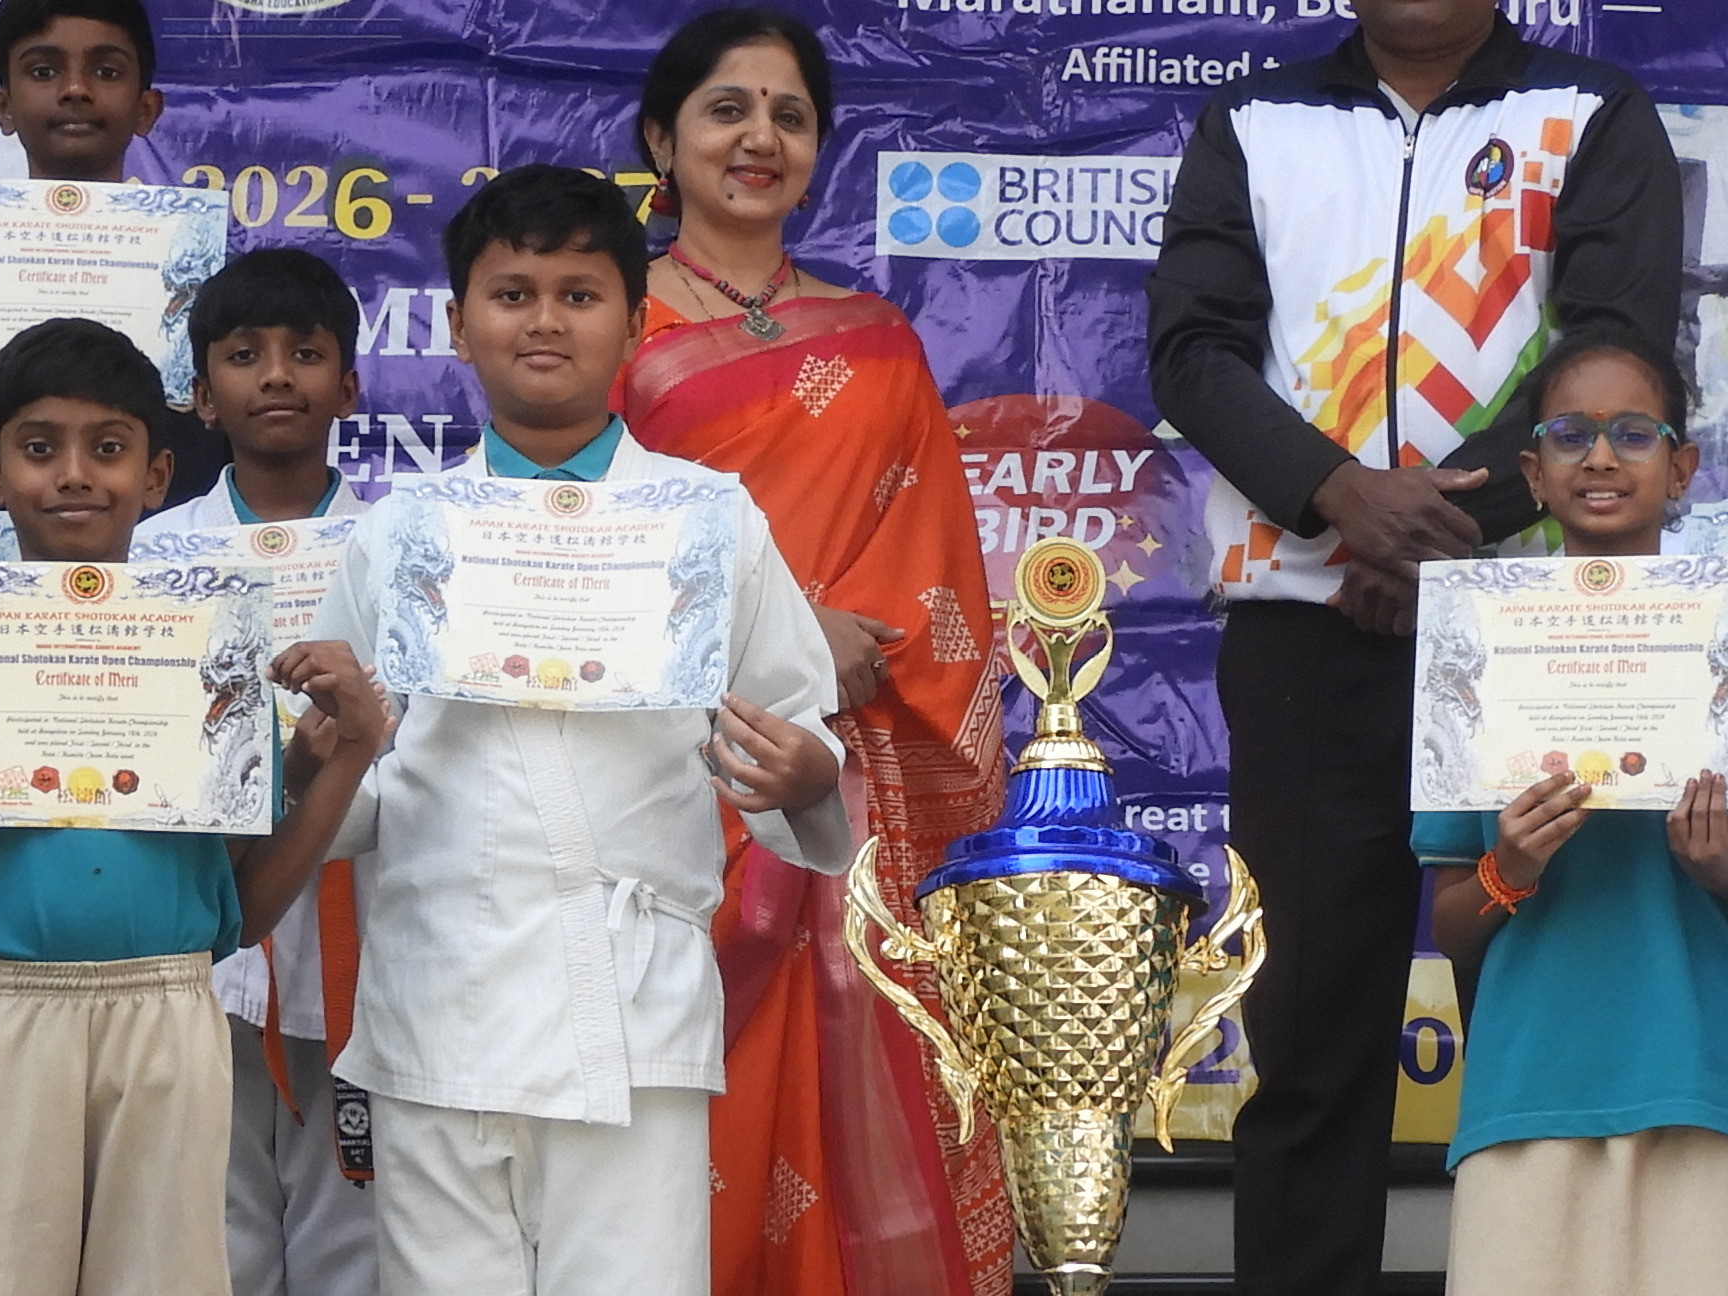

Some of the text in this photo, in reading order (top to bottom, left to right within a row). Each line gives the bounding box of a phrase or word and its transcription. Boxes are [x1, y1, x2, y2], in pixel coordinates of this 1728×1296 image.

[1061, 47, 1250, 85] Affiliated
[994, 209, 1165, 246] COUNC
[18, 268, 107, 285] Certificate of Merit
[960, 449, 1154, 495] EARLY
[468, 519, 666, 533] JAPAN KARATE SHOTOKAN ACADEMY
[975, 506, 1118, 555] BIRD
[462, 555, 665, 572] National Shotokan Karate Open Championship
[512, 572, 610, 591] Certificate of Merit
[1498, 602, 1701, 614] JAPAN KARATE SHOTOKAN ACADEMY
[25, 611, 69, 620] KARATE
[74, 612, 136, 621] SHOTOKAN
[140, 614, 193, 623] ACADEMY
[1493, 643, 1703, 655] National Shotokan Karate Open Championship
[21, 654, 66, 664] Shotokan
[68, 655, 99, 665] Karate
[102, 655, 125, 666] Open
[128, 656, 195, 668] Championship
[1547, 658, 1646, 674] Certificate of Merit
[35, 670, 138, 687] Certificate of Merit
[1117, 797, 1208, 832] reat
